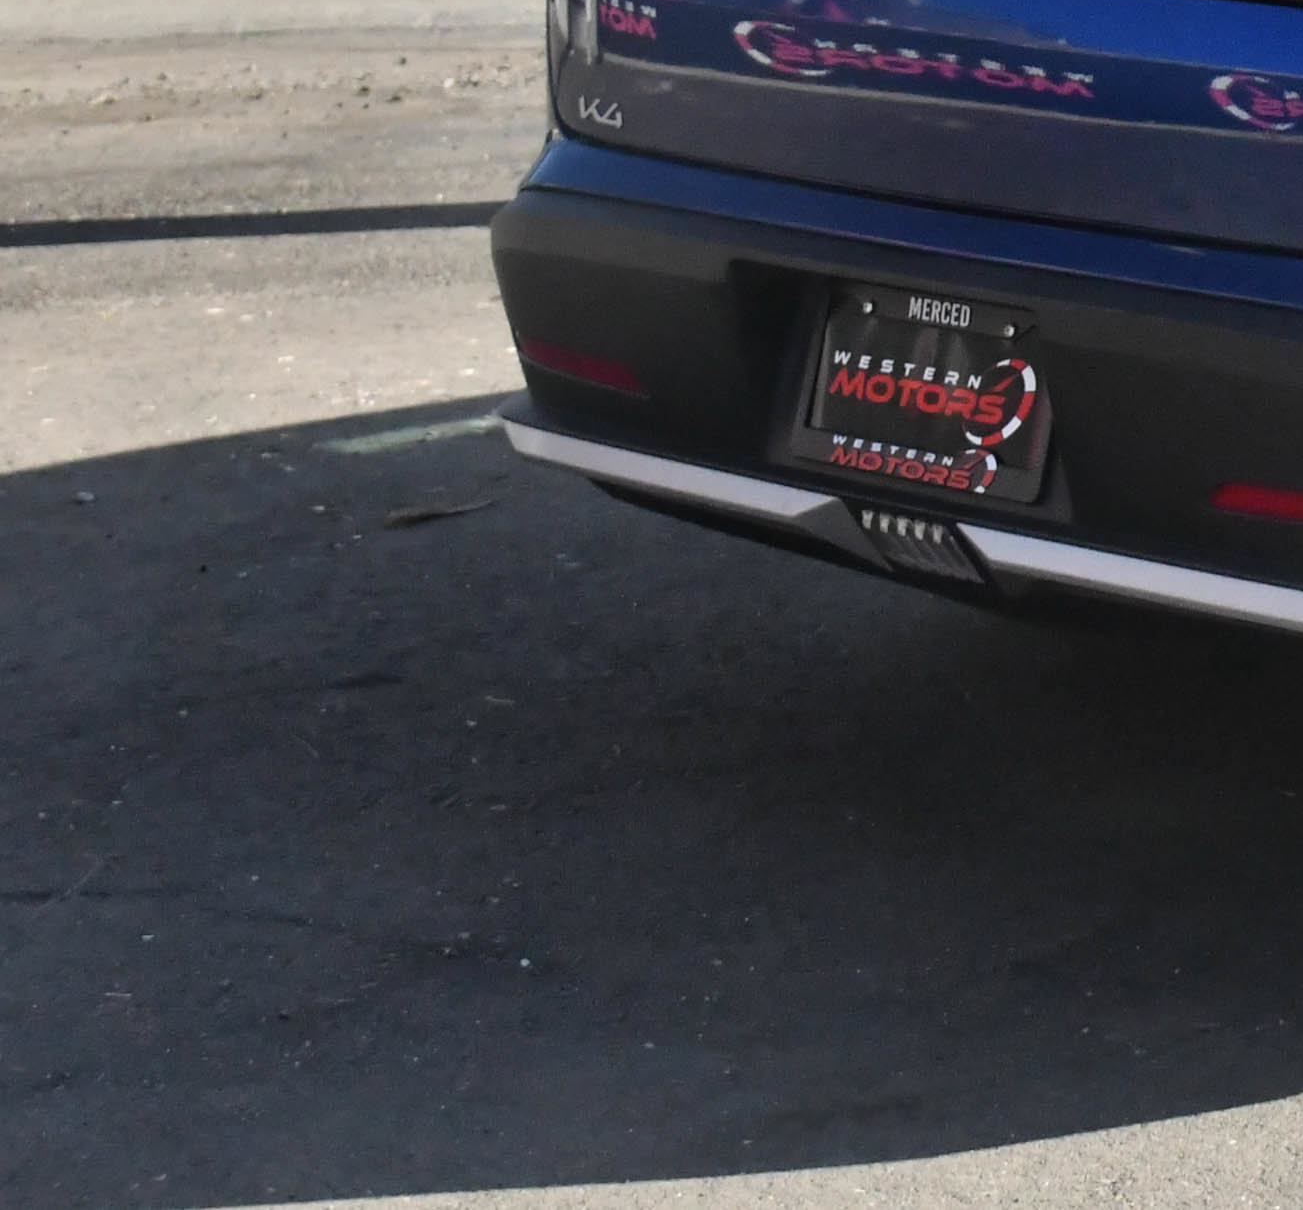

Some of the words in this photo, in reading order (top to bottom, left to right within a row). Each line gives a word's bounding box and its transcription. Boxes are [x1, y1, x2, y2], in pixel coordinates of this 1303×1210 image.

[577, 95, 622, 129] K4
[908, 296, 971, 328] MERCED
[833, 350, 983, 390] WESTERN
[829, 367, 1006, 425] MOTORS
[829, 445, 972, 490] MOTORS
[831, 434, 954, 467] WESTERN
